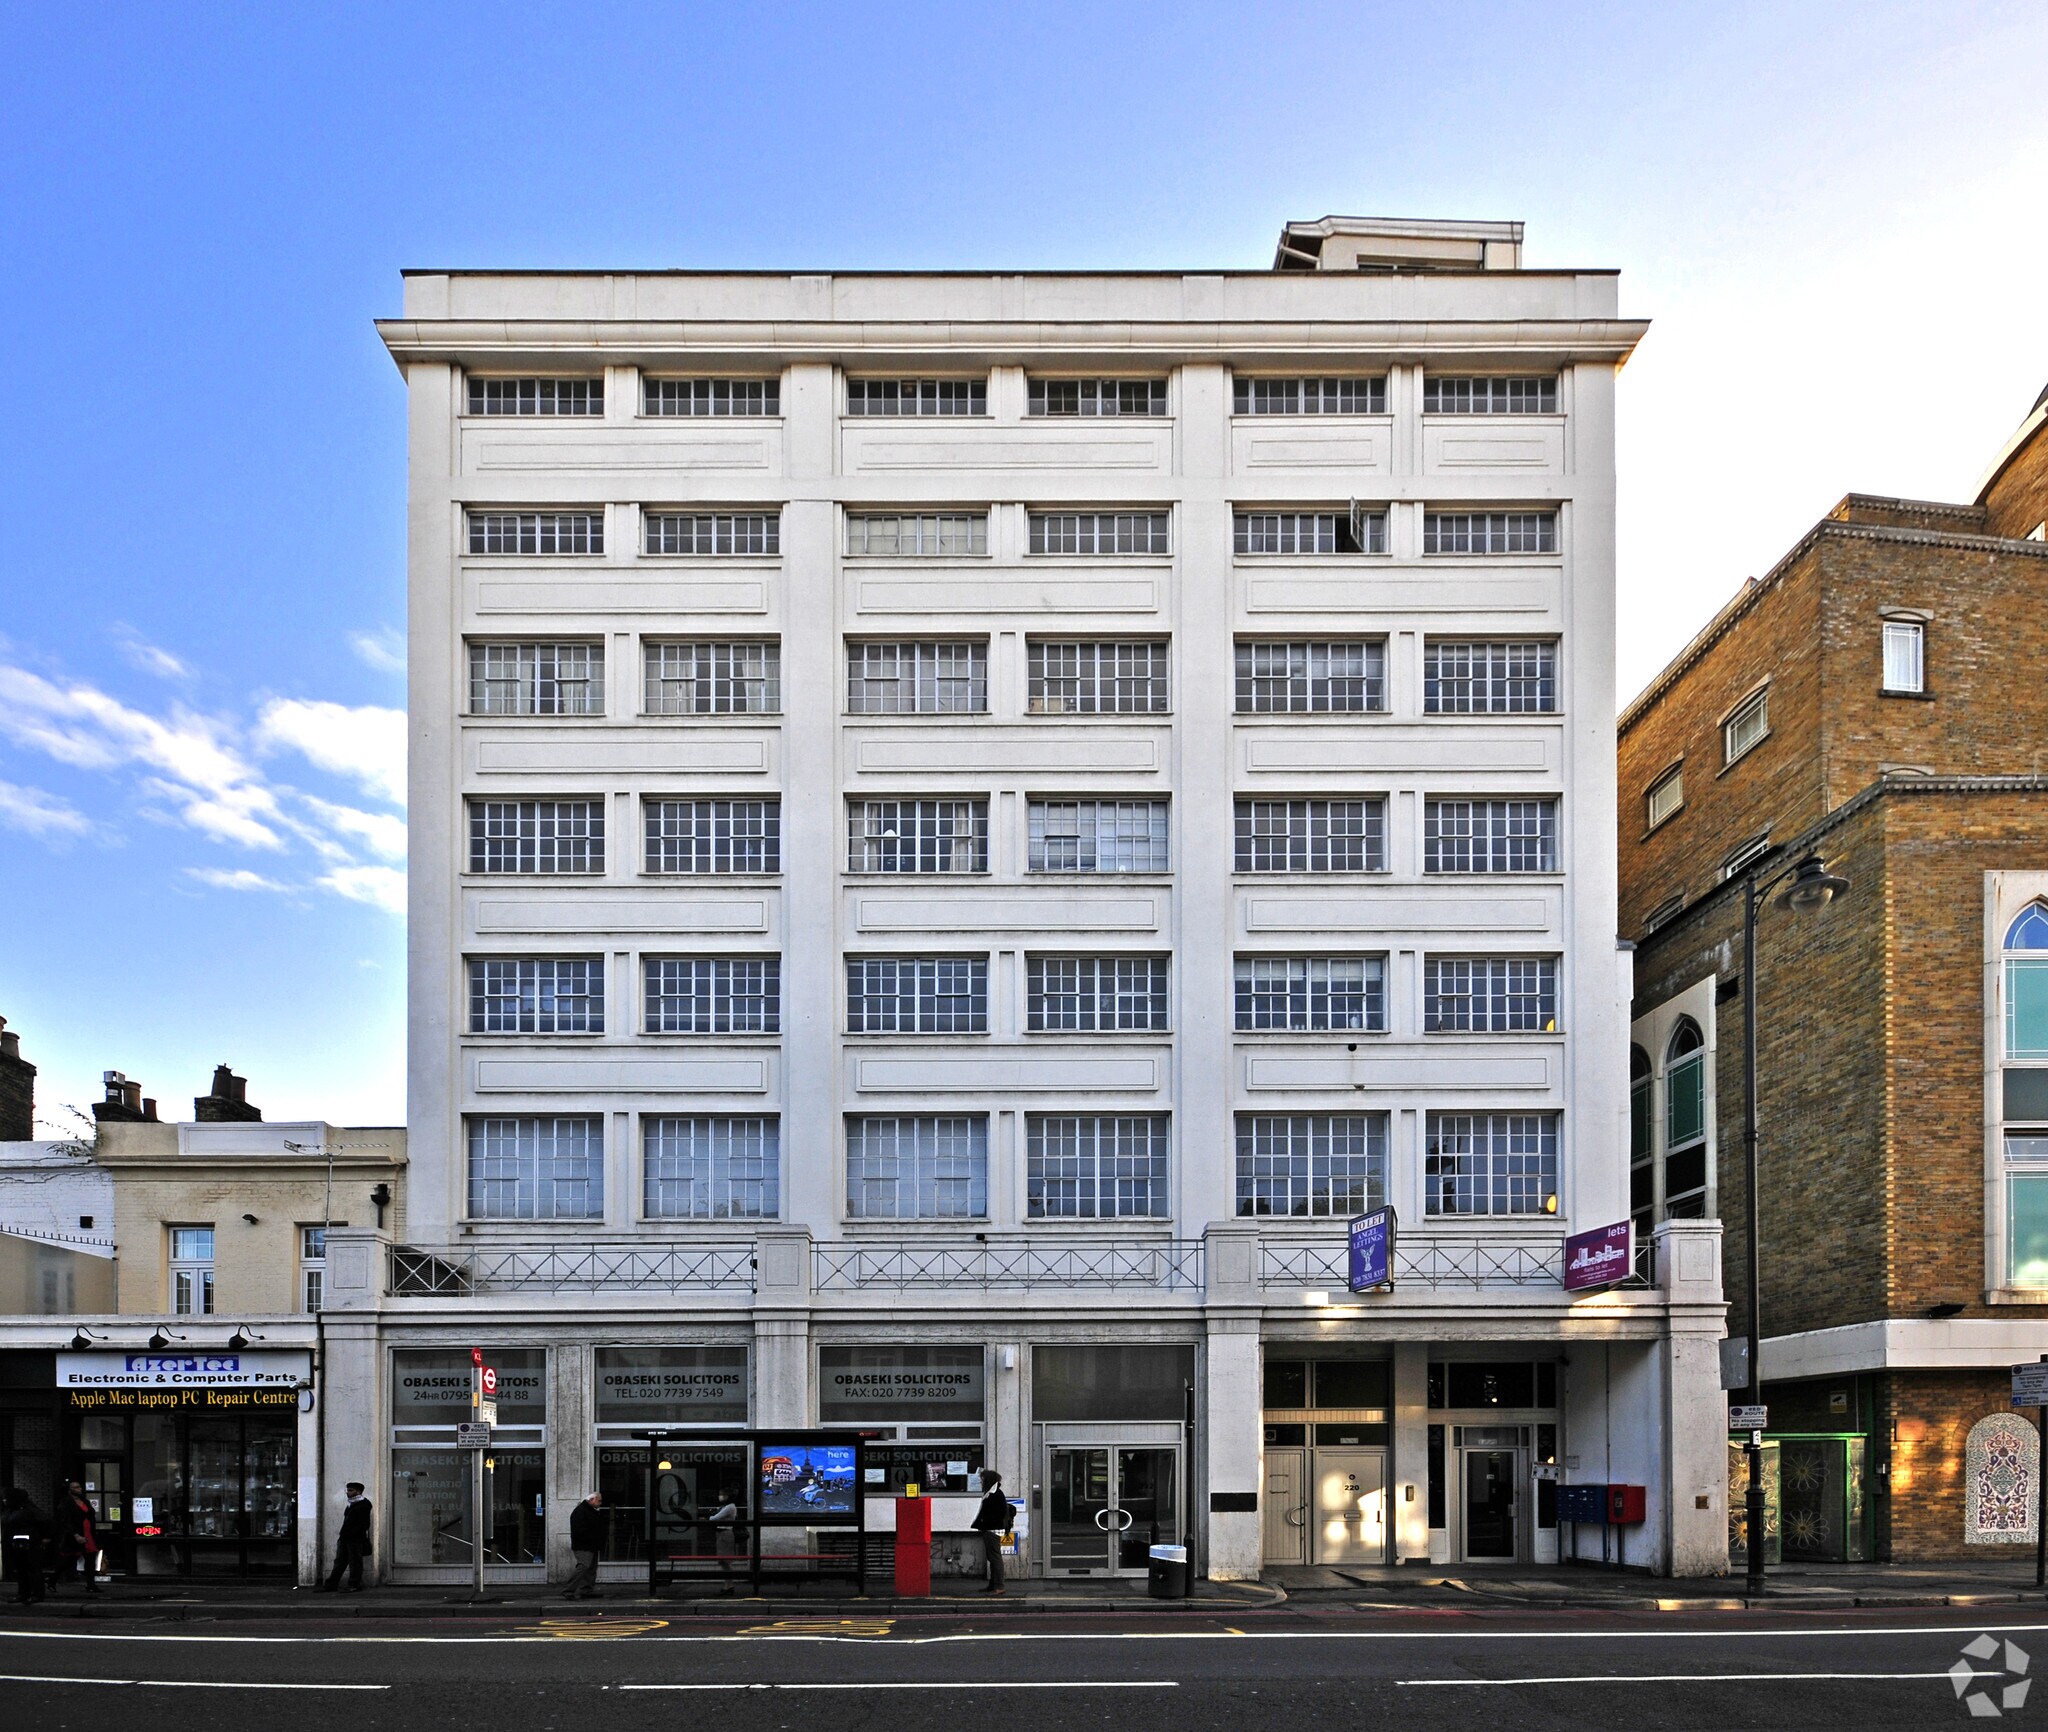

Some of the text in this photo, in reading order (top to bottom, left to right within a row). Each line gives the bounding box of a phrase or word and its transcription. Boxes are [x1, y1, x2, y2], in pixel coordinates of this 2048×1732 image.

[1355, 1215, 1383, 1231] TO LET
[1358, 1228, 1378, 1241] ANGEL
[1608, 1226, 1626, 1238] lets
[68, 1373, 298, 1384] Electronic & Computer Parts
[403, 1377, 539, 1387] OBASEKI SCITORS
[604, 1374, 739, 1385] OBASEKI SOLICITORS
[834, 1373, 971, 1385] OBASEKI SOLICITORS
[413, 1391, 439, 1400] 24HR
[514, 1391, 528, 1400] 88
[615, 1388, 724, 1398] TEL: 020 7739 7549
[845, 1387, 957, 1398] FAX: 020 7739 8209
[70, 1389, 296, 1408] Apple Mac laptop PC Repair Centre
[663, 1452, 741, 1463] SOLICITORS
[827, 1451, 849, 1459] here
[893, 1451, 972, 1462] SOLICITORS
[135, 1527, 161, 1535] OPEN
